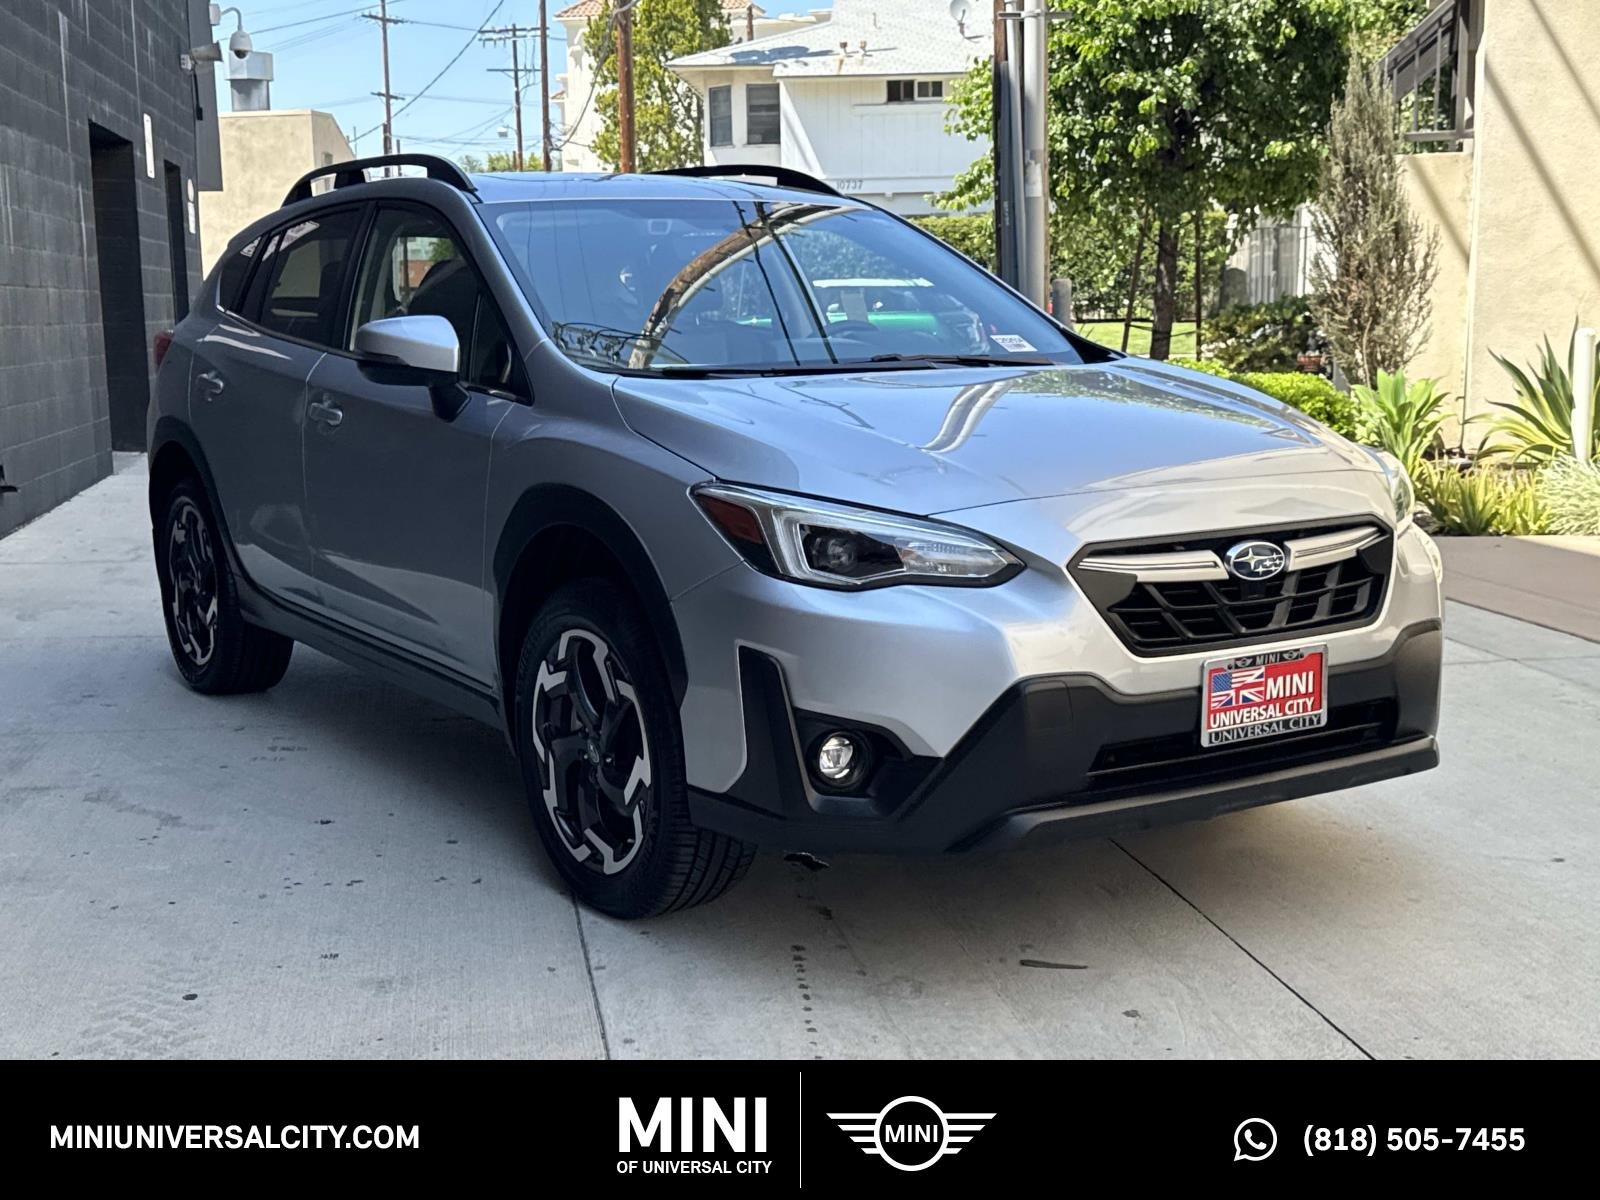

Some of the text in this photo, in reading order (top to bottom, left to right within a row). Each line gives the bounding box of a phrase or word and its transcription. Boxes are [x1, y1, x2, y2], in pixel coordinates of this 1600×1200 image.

[1255, 653, 1280, 666] MINI
[1266, 671, 1314, 701] MINI
[1210, 697, 1314, 728] UNIVERSAL CITY
[1211, 715, 1320, 743] UNIVERSAL CITY
